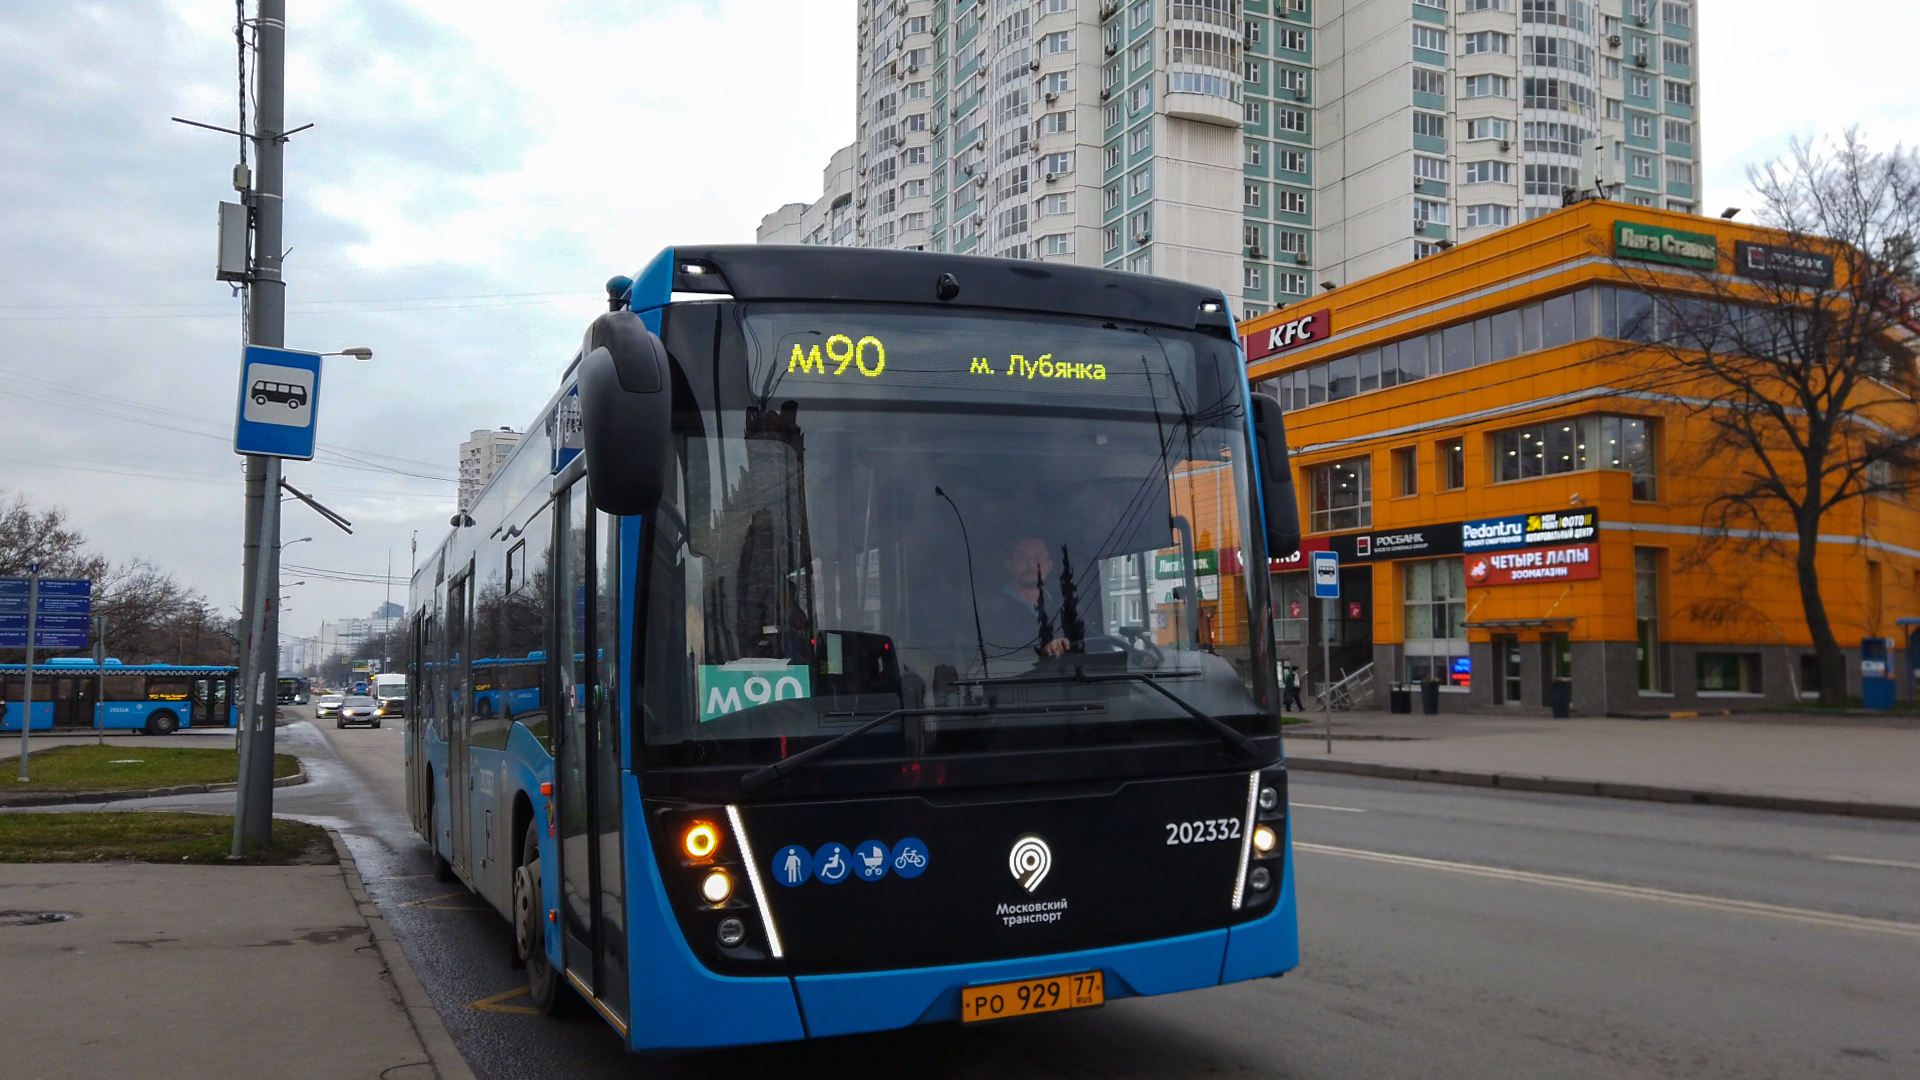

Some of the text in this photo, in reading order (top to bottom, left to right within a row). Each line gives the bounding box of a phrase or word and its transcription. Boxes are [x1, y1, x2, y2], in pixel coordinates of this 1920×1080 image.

[1267, 316, 1312, 350] KFC
[1006, 353, 1107, 380] Лубянка
[1463, 521, 1522, 539] Pedant.ru
[1561, 515, 1585, 528] ФОТО
[1376, 533, 1424, 547] РОСБАНК
[1491, 548, 1590, 569] ЧЕТЫРЕ ЛАПЫ
[1511, 567, 1568, 580] ЗООМАГАЗИН
[1165, 817, 1241, 845] 202332
[995, 898, 1068, 915] Московский
[1002, 911, 1062, 927] транспорт
[1017, 982, 1061, 1011] 929
[1074, 976, 1095, 996] 77
[1076, 996, 1093, 1004] RUS
